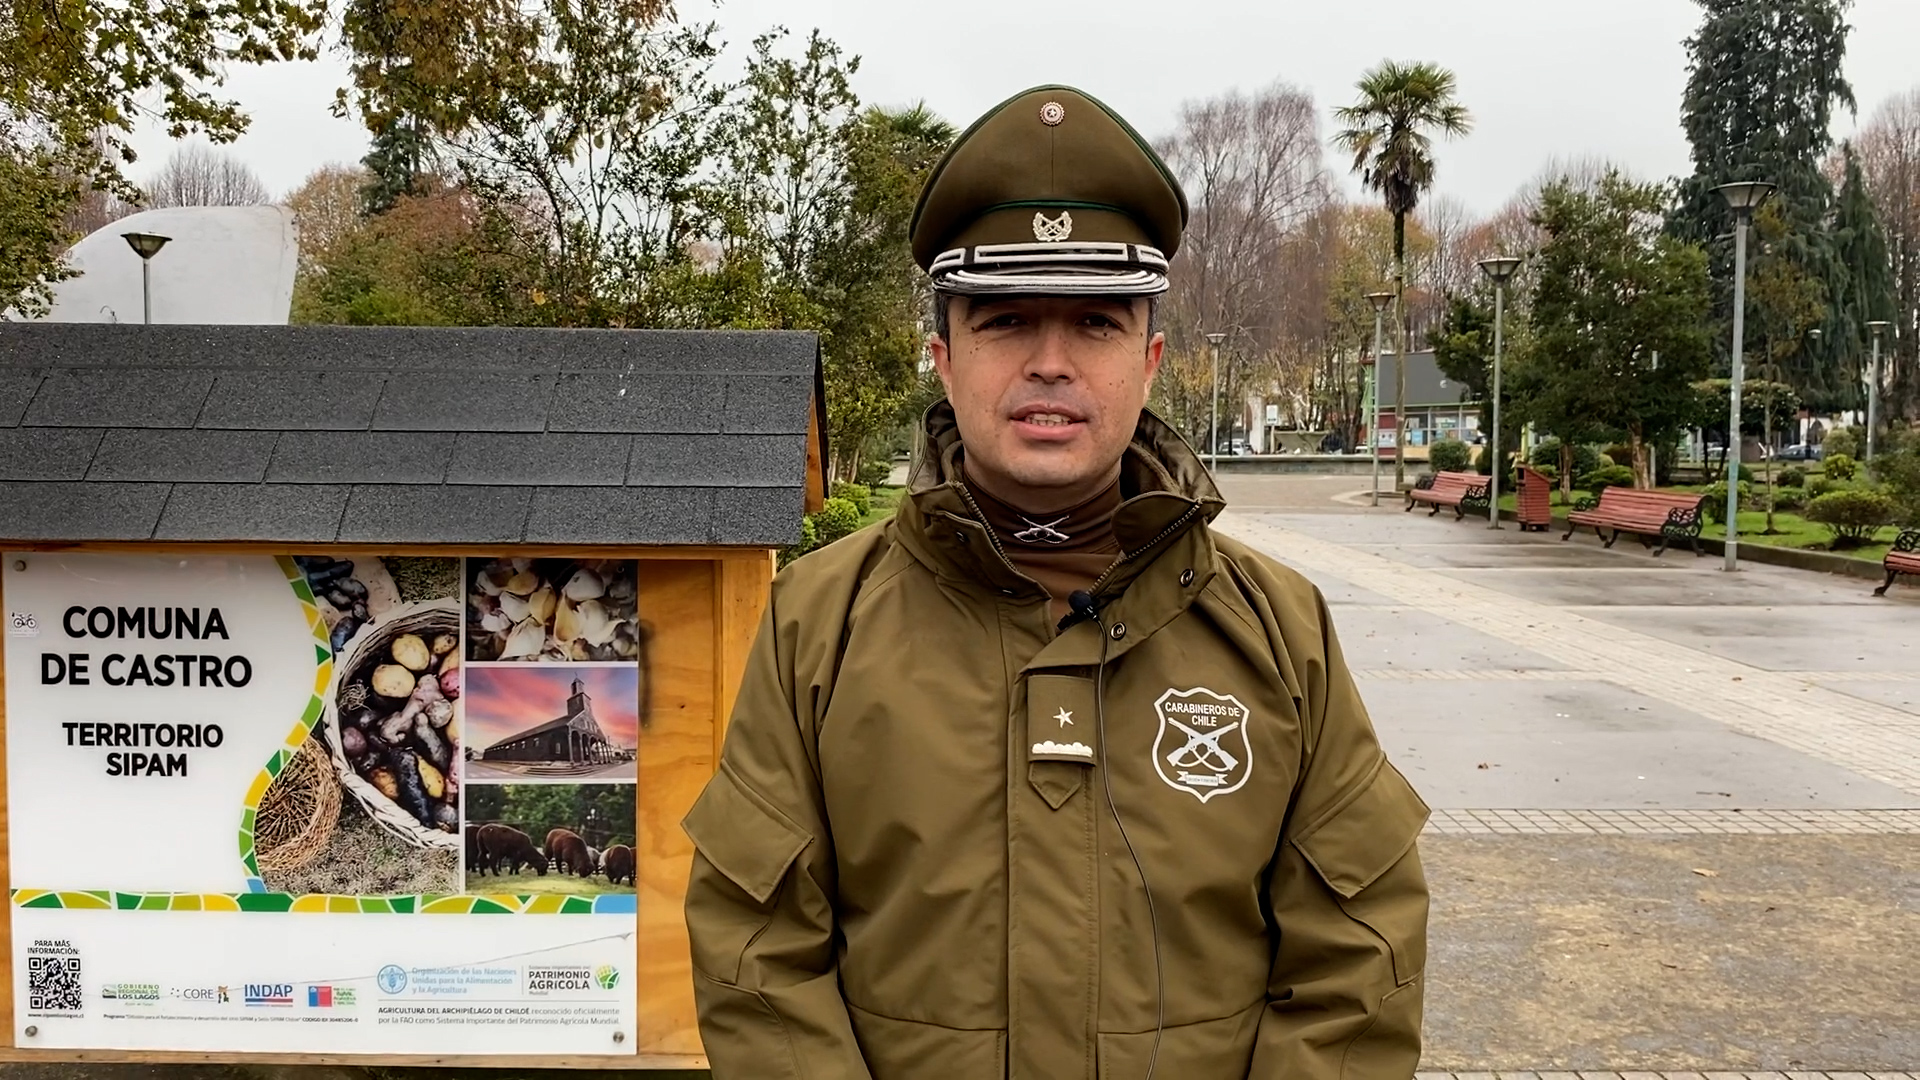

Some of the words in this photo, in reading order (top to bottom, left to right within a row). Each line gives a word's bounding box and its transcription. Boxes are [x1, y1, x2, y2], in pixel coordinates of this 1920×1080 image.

[62, 606, 229, 640] COMUNA
[41, 653, 91, 685] DE
[101, 653, 253, 688] CASTRO
[1165, 702, 1227, 716] CARABINEROS
[1228, 707, 1241, 717] DE
[1191, 715, 1217, 727] CHILE
[62, 722, 224, 748] TERRITORIO
[106, 753, 188, 777] SIPAM
[54, 939, 71, 947] MÁS
[27, 947, 80, 955] INFORMACIÓN:
[412, 967, 459, 977] Organización
[461, 967, 470, 975] de
[472, 967, 482, 975] las
[484, 967, 517, 975] Naciones
[528, 971, 591, 979] PATRIMONIO
[438, 977, 455, 985] para
[465, 976, 513, 984] Alimentación
[528, 980, 590, 990] AGRÍCOLA
[183, 988, 214, 1000] CORE
[244, 984, 293, 998] INDAP
[426, 987, 468, 995] Agricultura
[441, 1006, 493, 1014] ARCHIPIÉLAGO
[504, 1007, 529, 1015] CHILOÉ
[466, 1017, 505, 1025] Importante
[560, 1017, 589, 1026] Agrícola
